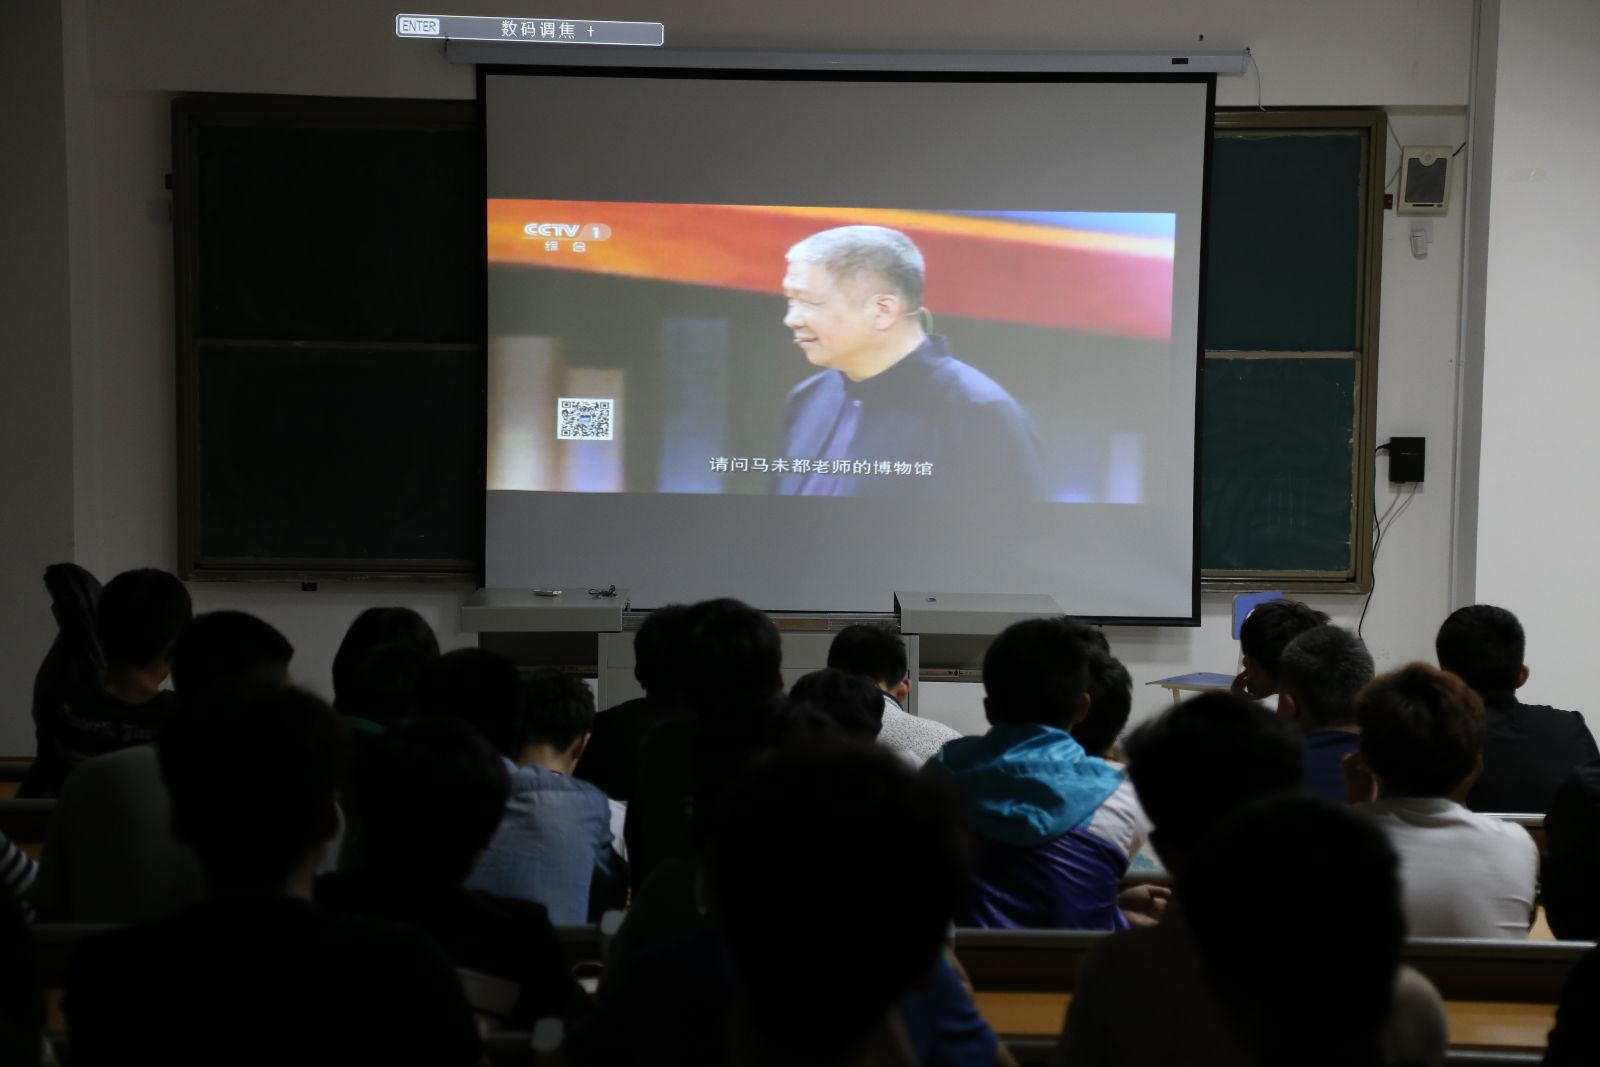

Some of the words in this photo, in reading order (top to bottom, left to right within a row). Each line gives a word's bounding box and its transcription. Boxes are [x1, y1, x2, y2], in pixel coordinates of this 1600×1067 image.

[402, 19, 437, 33] ENTER
[501, 20, 576, 39] 数码调焦
[523, 223, 580, 237] CCTV
[709, 456, 934, 476] 请问马未都老师的博物馆
